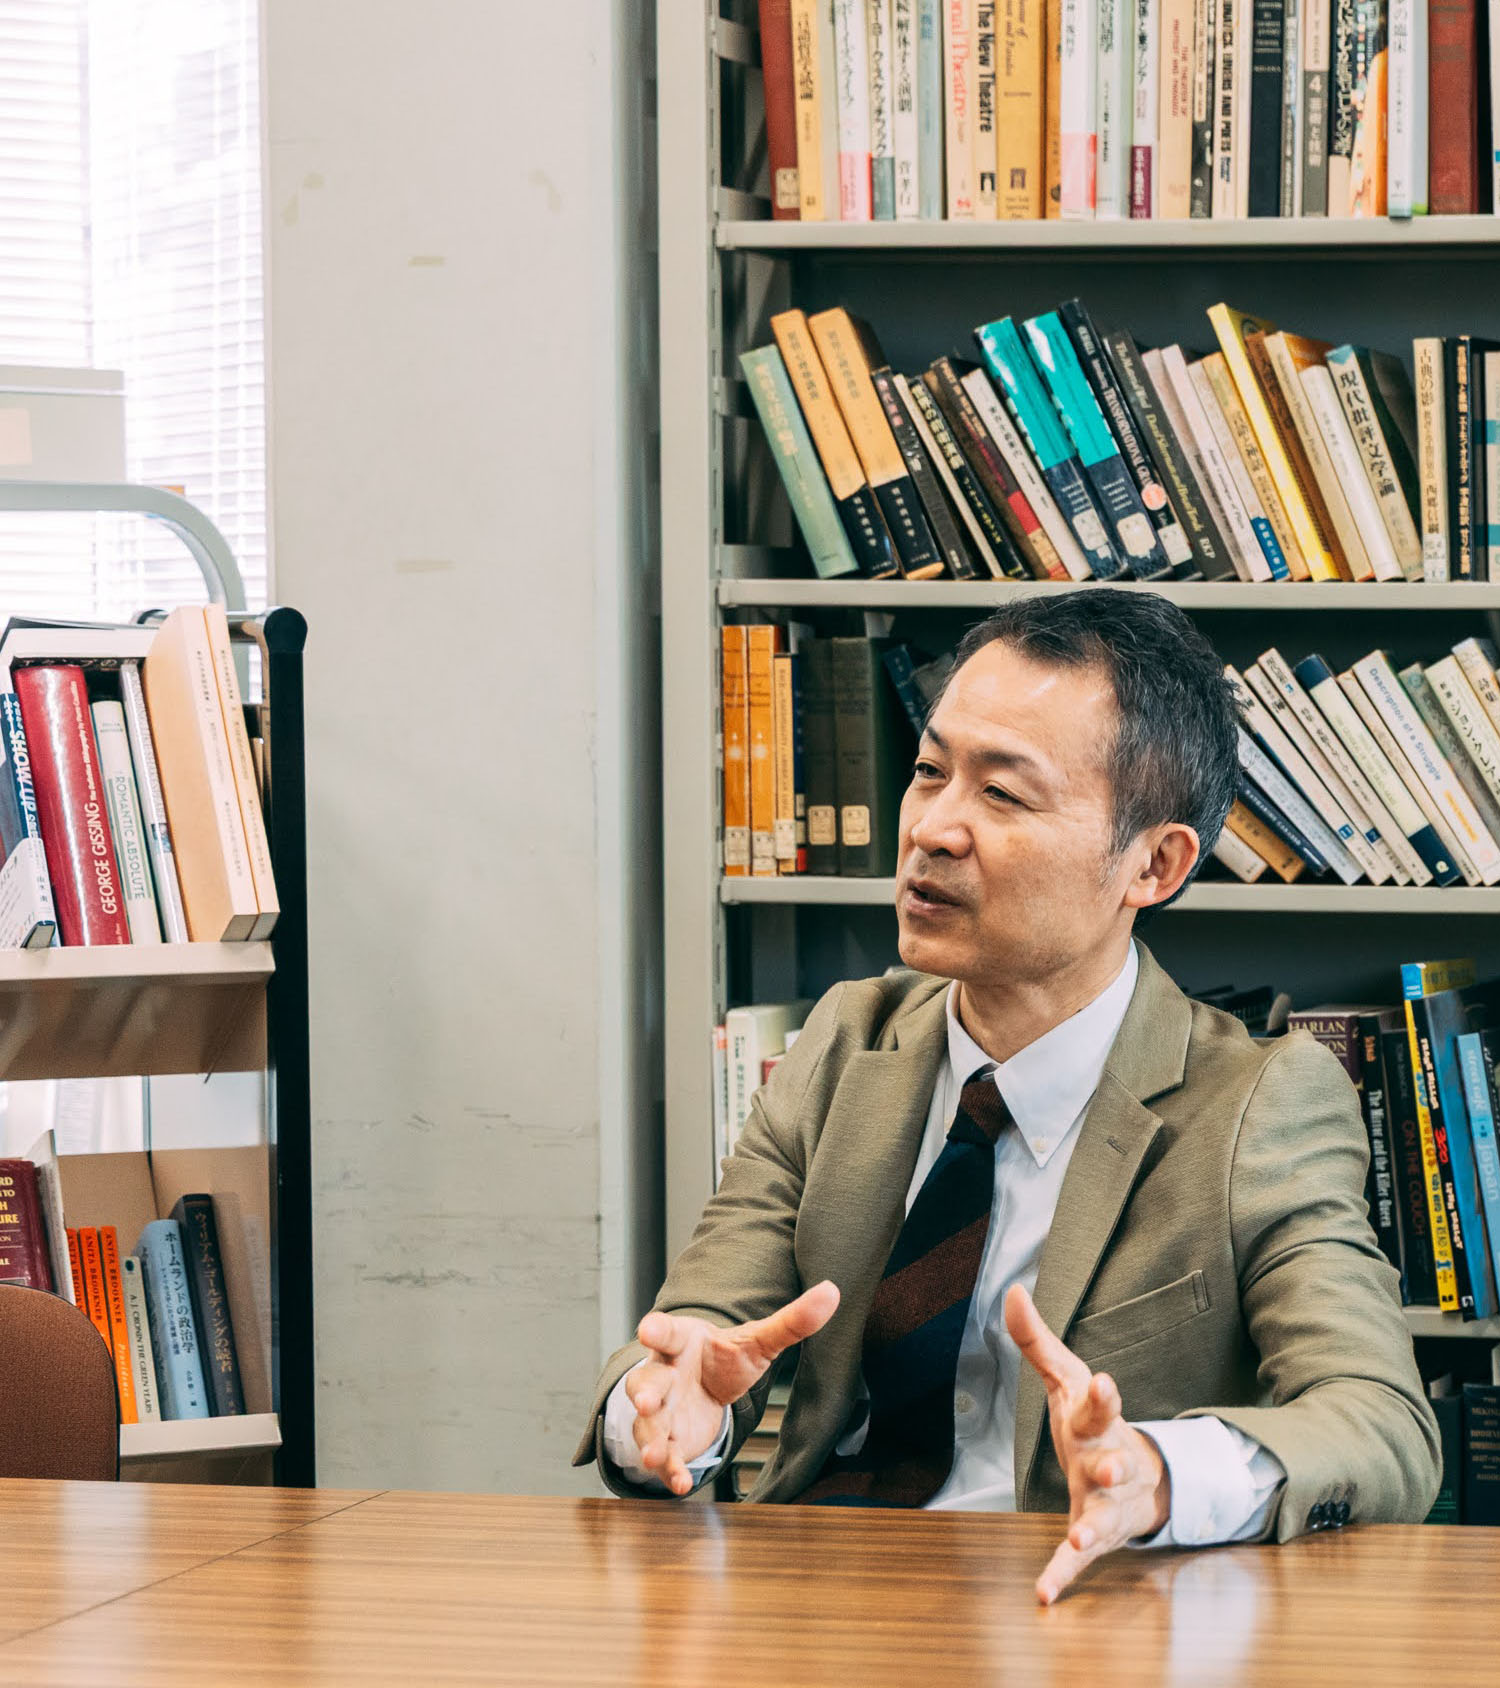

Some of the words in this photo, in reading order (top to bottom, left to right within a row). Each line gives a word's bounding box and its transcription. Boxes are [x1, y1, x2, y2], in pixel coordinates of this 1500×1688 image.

[977, 2, 995, 27] The
[978, 32, 996, 66] New
[977, 73, 997, 132] Theatre
[1367, 667, 1406, 723] Description
[1402, 721, 1414, 733] of
[1412, 741, 1443, 782] Struggle
[9, 728, 32, 786] SHOW
[83, 800, 107, 856] GISSING
[114, 775, 134, 835] ROMANTIC
[124, 839, 145, 899] ABSOLUTE
[93, 857, 117, 914] GEORGE
[1288, 1020, 1346, 1033] HARLAN
[1368, 1090, 1382, 1106] The
[1372, 1136, 1387, 1155] and
[1402, 1119, 1416, 1145] ON
[1433, 1126, 1451, 1164] 300
[1374, 1156, 1388, 1171] the
[1405, 1150, 1419, 1174] THE
[1407, 1180, 1425, 1235] COUCH
[83, 1235, 96, 1264] ANITA
[103, 1233, 115, 1264] ANITA
[108, 1268, 122, 1323] BROOKNER
[165, 1231, 194, 1354] ホームランドの政治学
[117, 1343, 131, 1397] Providence
